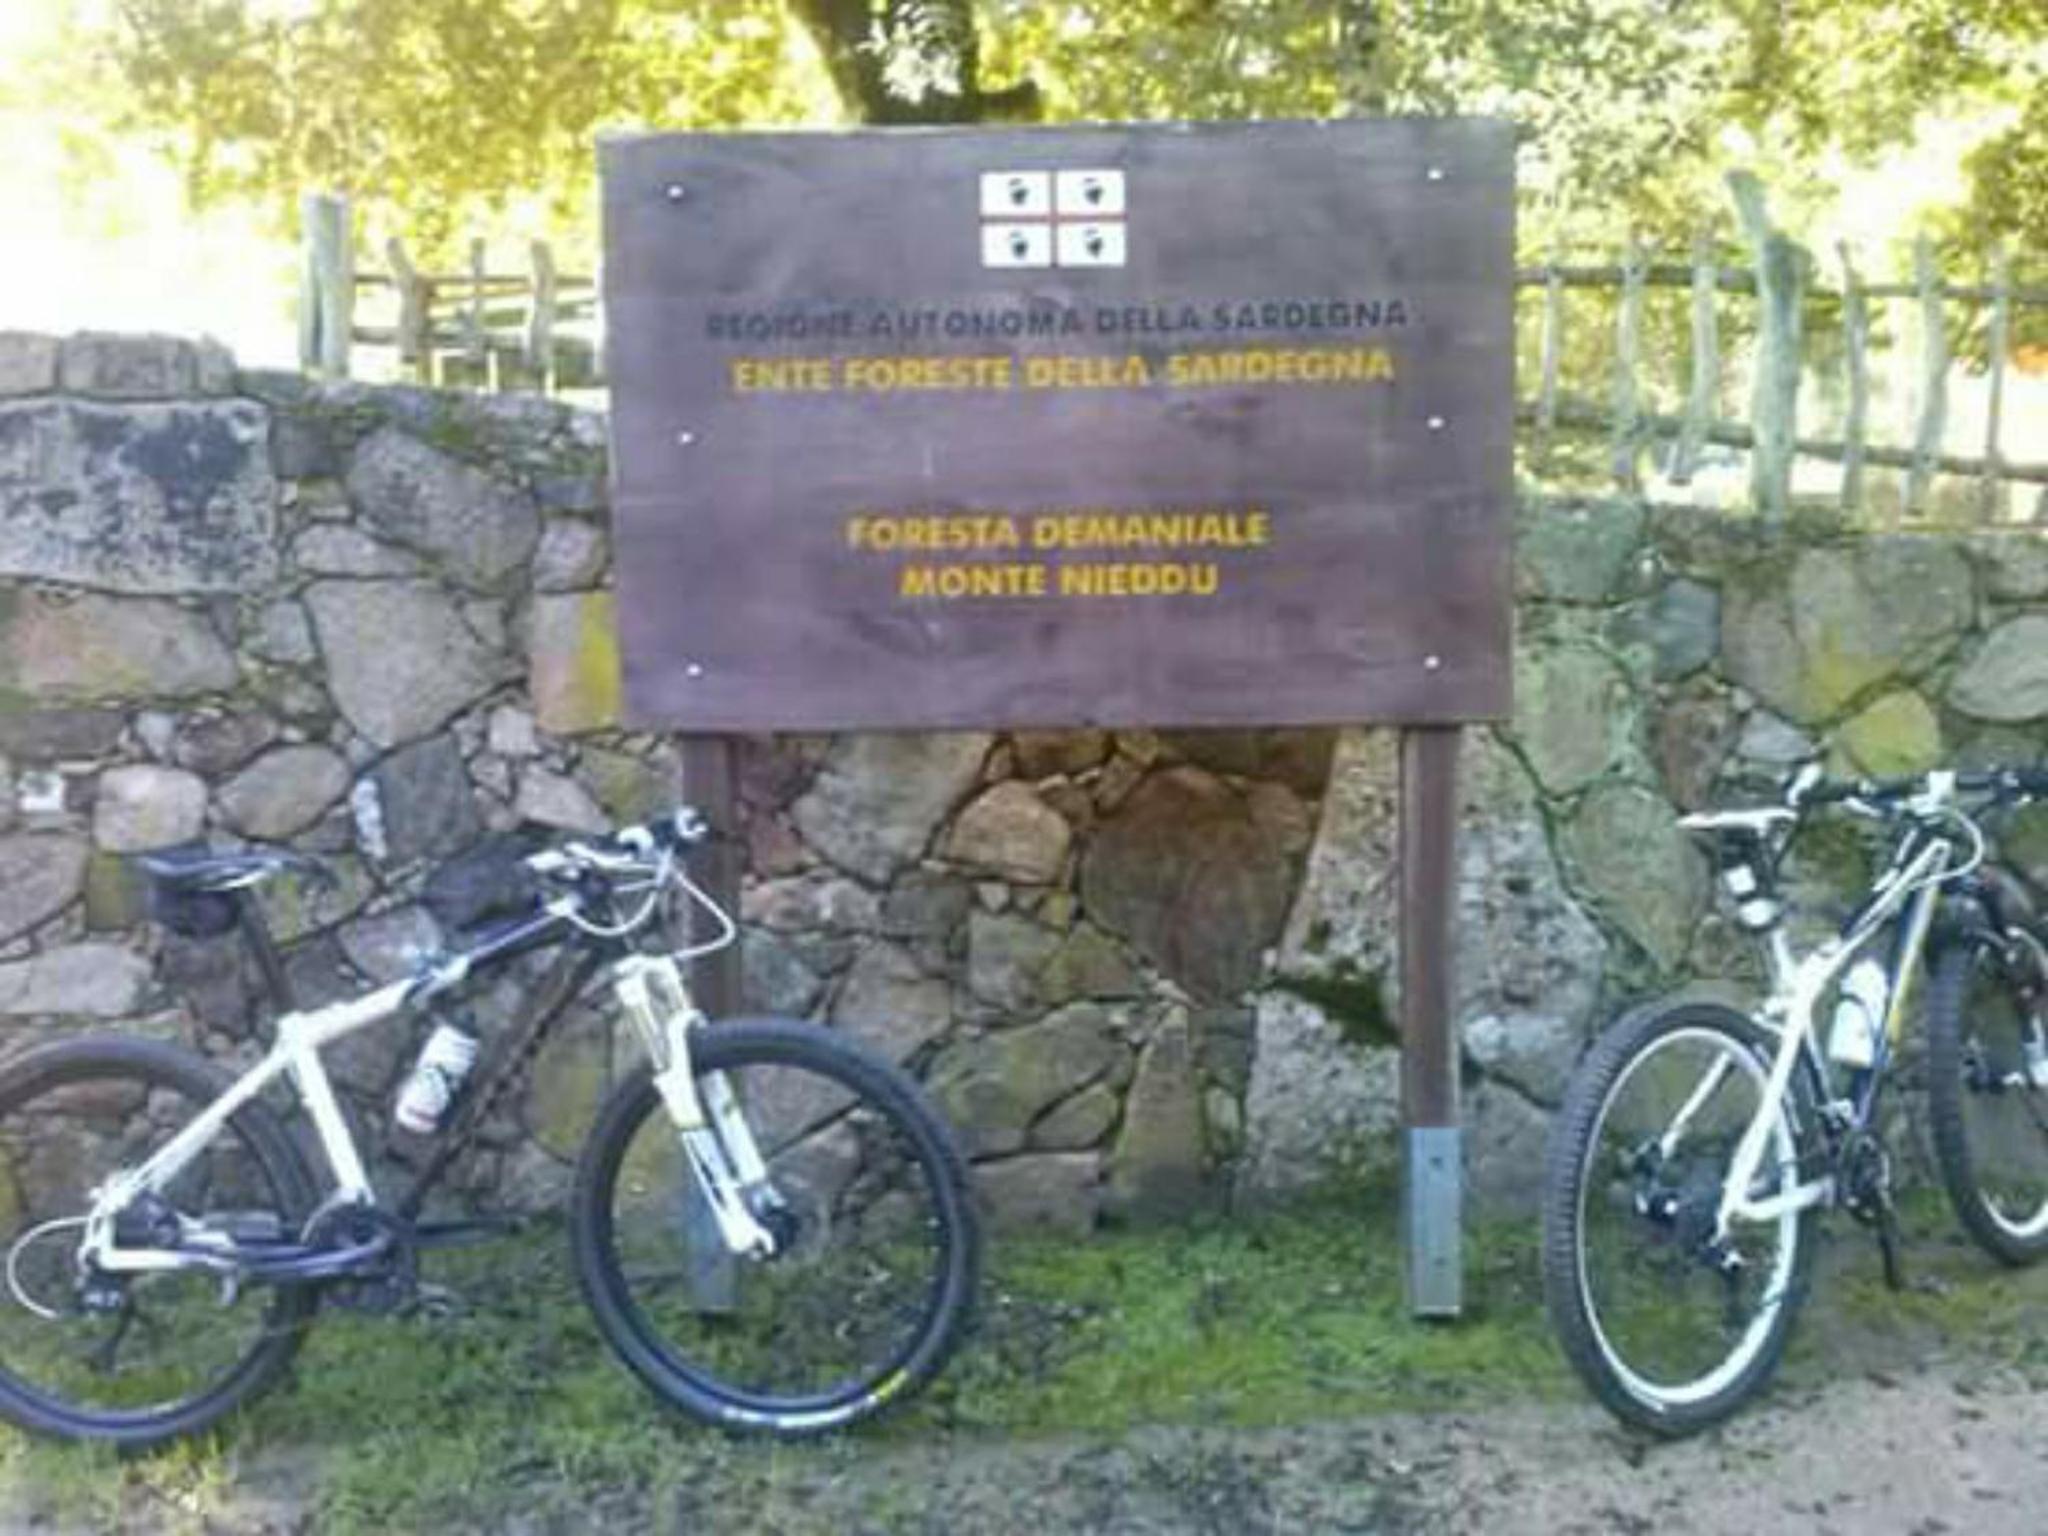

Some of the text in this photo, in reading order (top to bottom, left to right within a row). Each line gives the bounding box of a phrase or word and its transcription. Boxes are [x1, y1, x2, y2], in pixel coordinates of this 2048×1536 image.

[868, 307, 1082, 337] AUTONOMA
[1097, 304, 1200, 334] DELLA
[1213, 299, 1408, 330] SARDEGNA
[733, 348, 1397, 393] ENTE FORESTE DELLA SARDEGNA
[848, 510, 1271, 549] FORESTA DEMANIALE
[903, 562, 1219, 598] MONTE NIEDDU
